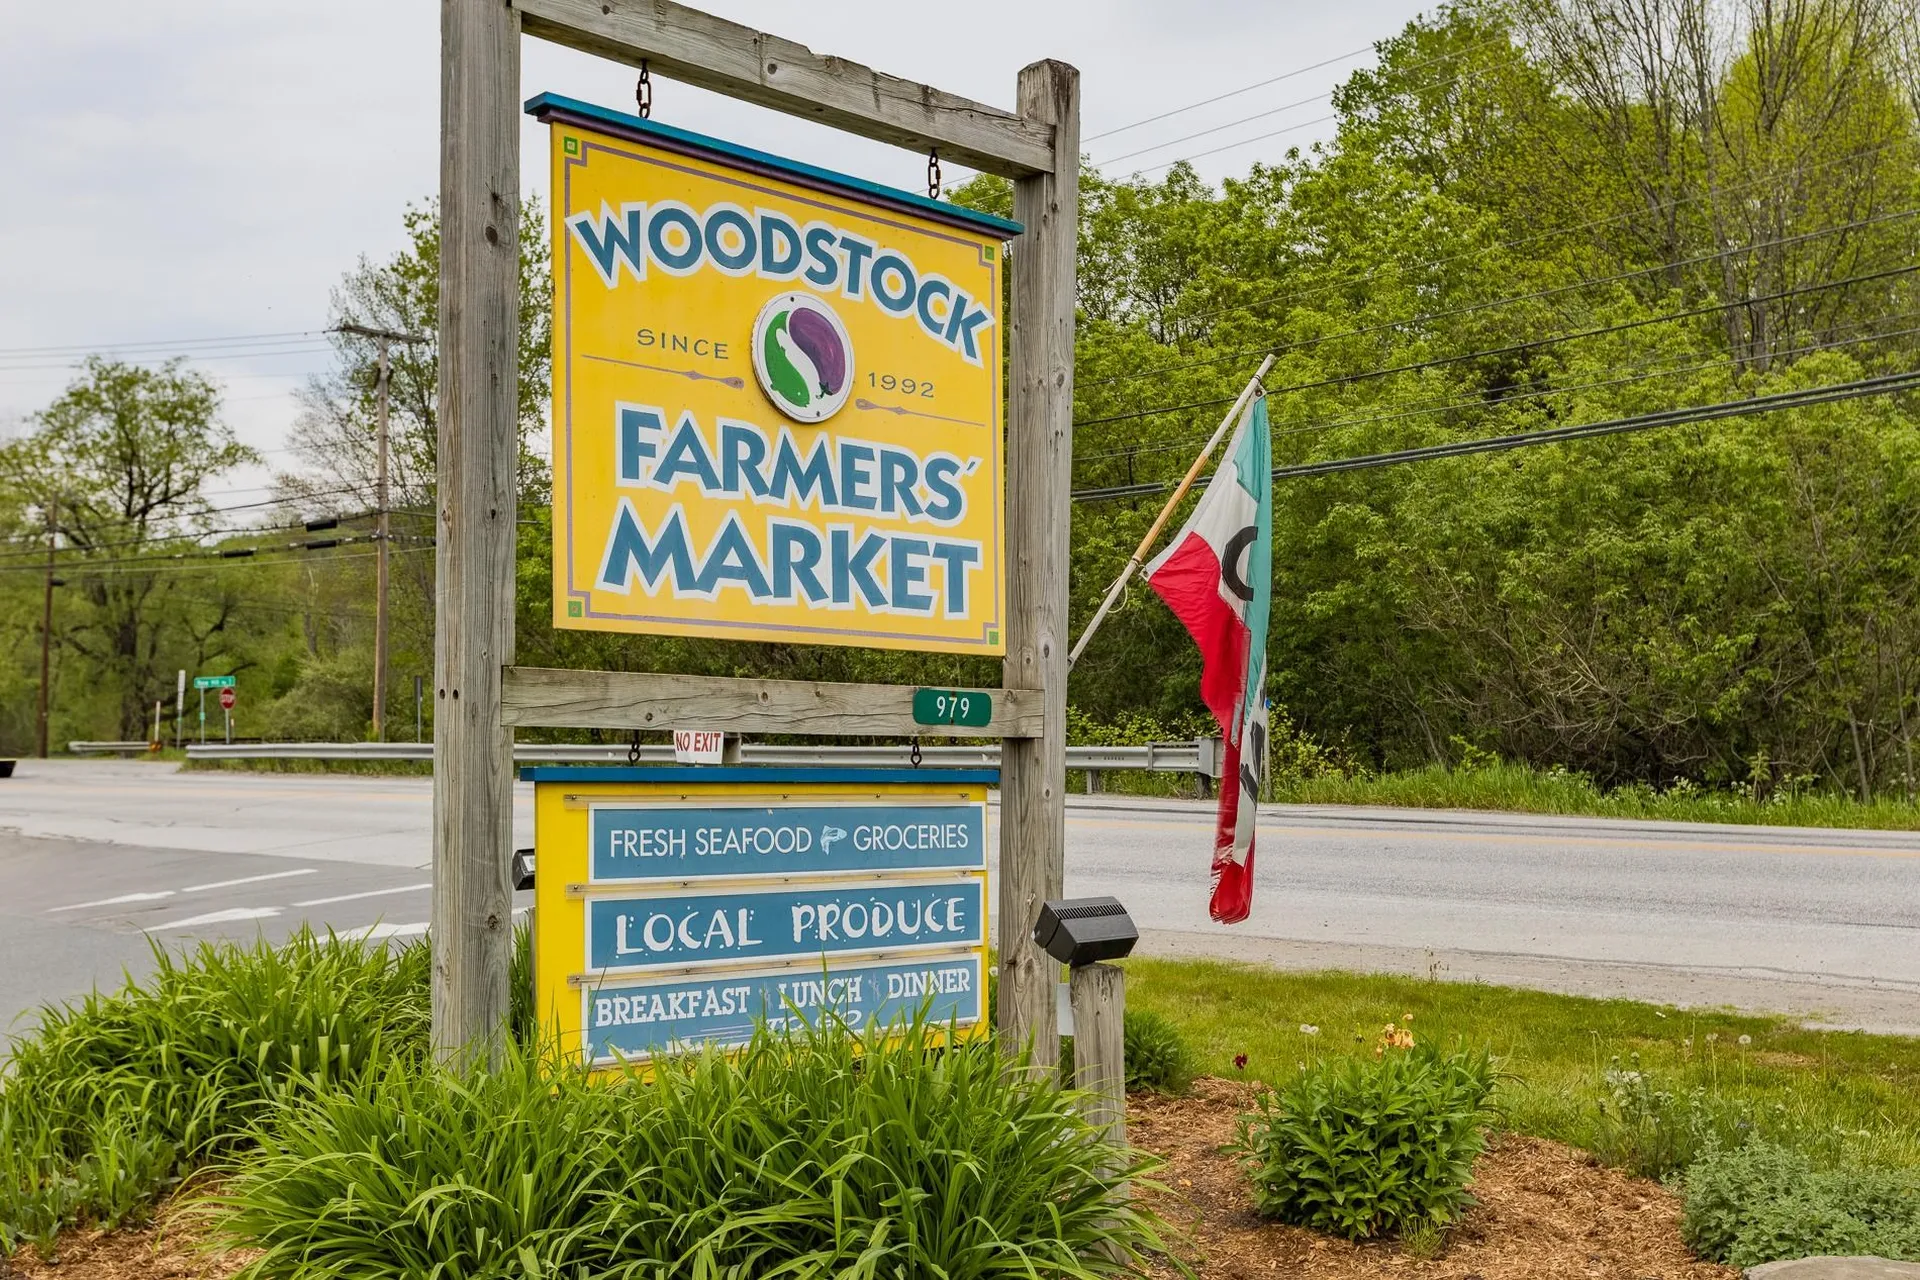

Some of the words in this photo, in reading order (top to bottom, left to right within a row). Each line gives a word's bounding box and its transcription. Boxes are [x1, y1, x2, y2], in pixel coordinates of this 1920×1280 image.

[570, 204, 992, 362] WOODSTOCK
[637, 328, 729, 360] SINCE
[868, 372, 934, 398] 1992
[600, 501, 981, 616] MARKET
[936, 695, 970, 720] 979
[675, 732, 691, 752] NO
[693, 732, 721, 752] EXIT
[610, 828, 686, 858] FRESH
[695, 826, 812, 855] SEAFOOD
[853, 824, 969, 851] GROCERIES
[615, 907, 763, 955] LOCAL
[791, 896, 966, 944] PRODUCE
[595, 986, 751, 1028] BREAKFAST
[778, 976, 863, 1009] LUNCH
[887, 967, 971, 999] DINNER
